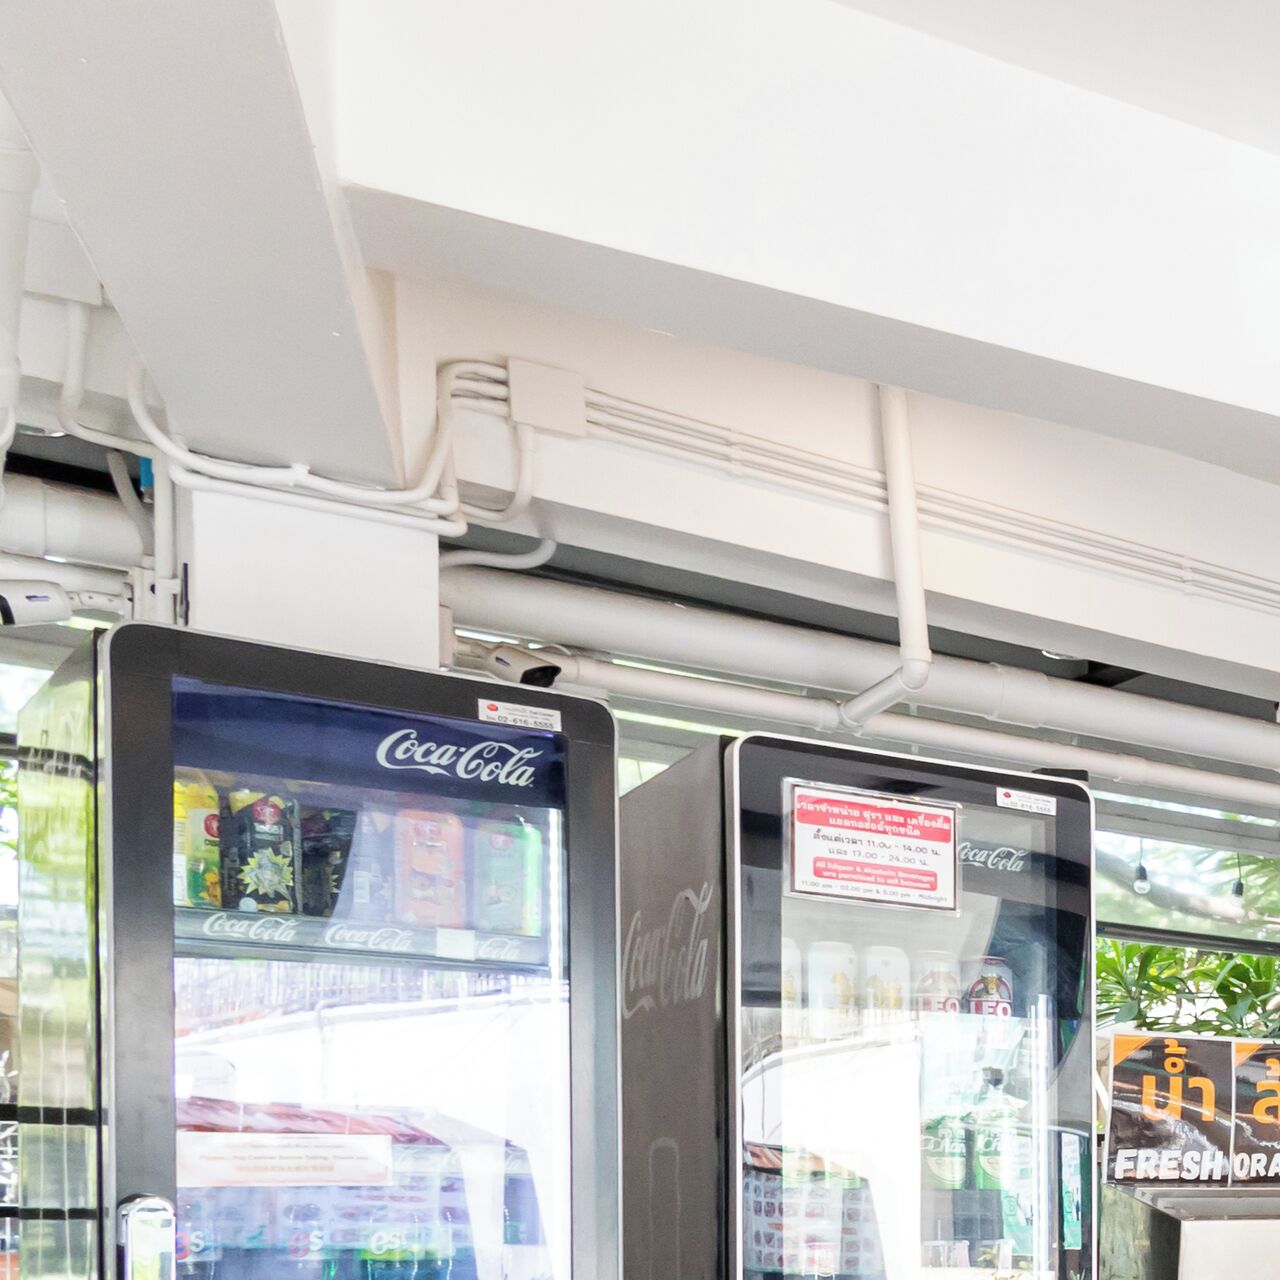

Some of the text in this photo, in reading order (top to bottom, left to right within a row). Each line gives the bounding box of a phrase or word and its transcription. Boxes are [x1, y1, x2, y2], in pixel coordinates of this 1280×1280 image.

[376, 728, 543, 788] Coca-Cola
[959, 842, 1029, 872] Coca-Cola
[202, 912, 299, 943] Coca-Cola
[324, 923, 414, 953] Coca-Cola
[1142, 1038, 1215, 1122] น้ำ
[1114, 1148, 1224, 1181] FRESH
